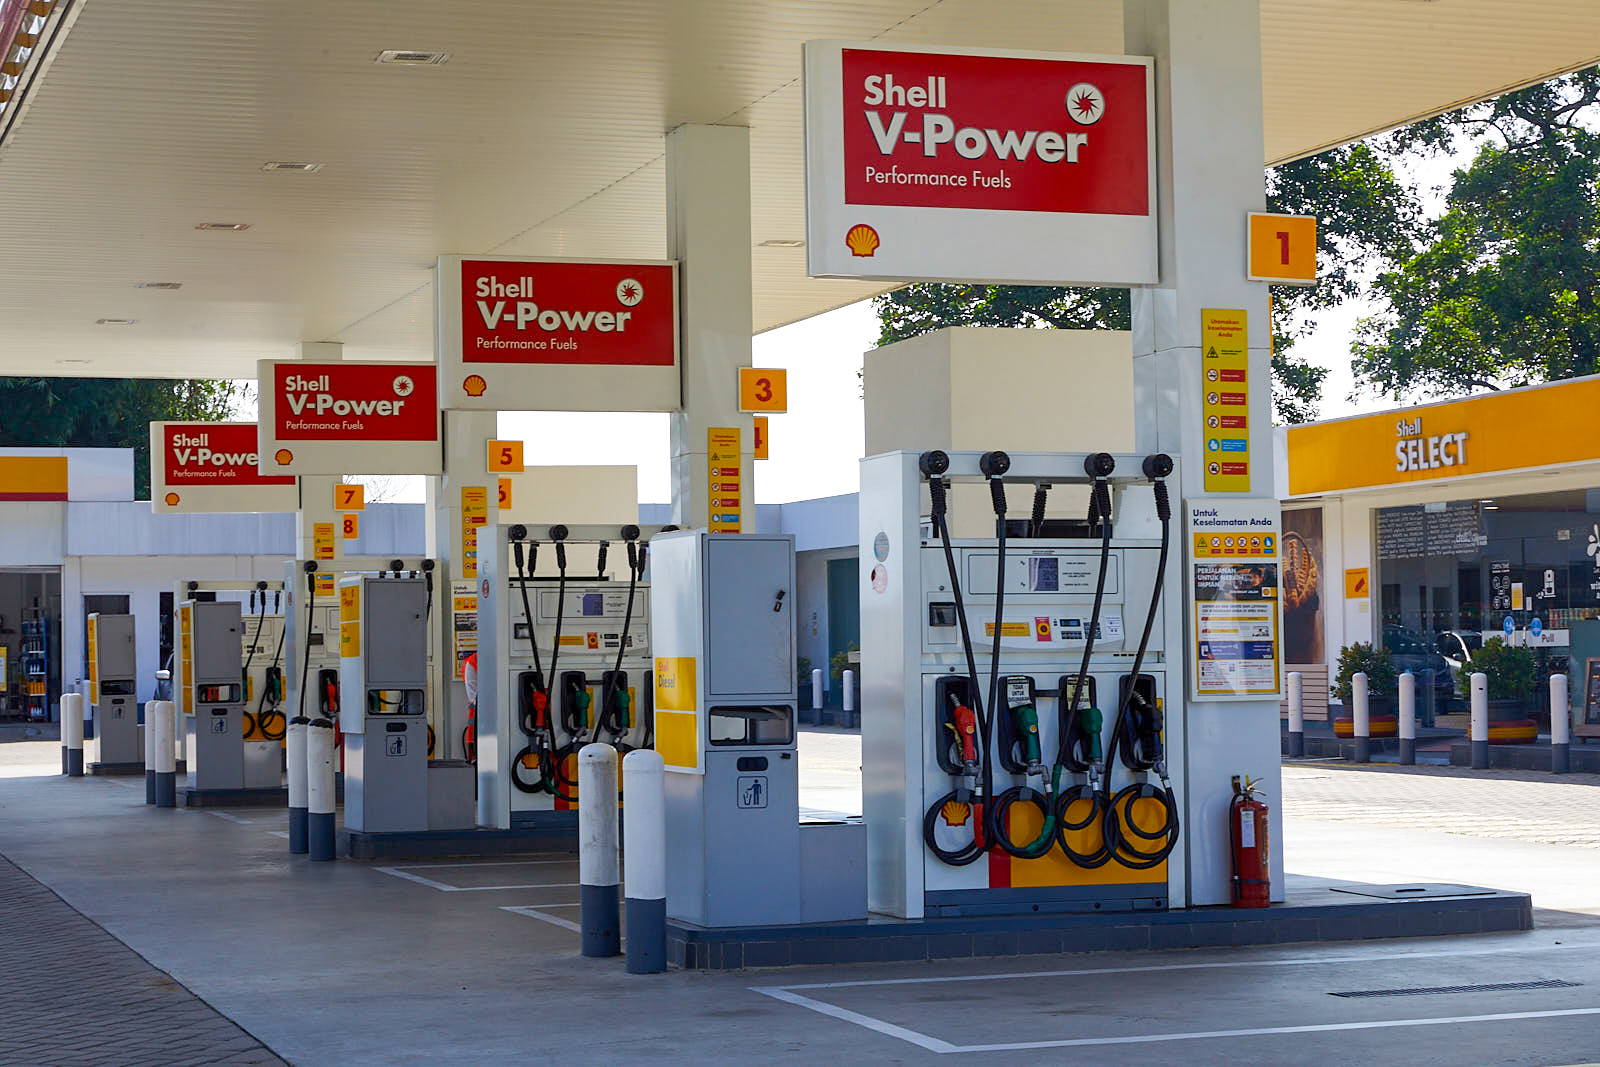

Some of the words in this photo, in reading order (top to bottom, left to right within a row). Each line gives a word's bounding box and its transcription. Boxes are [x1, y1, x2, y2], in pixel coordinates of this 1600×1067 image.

[863, 73, 947, 108] Shell
[864, 110, 1088, 164] V-Power
[865, 165, 968, 187] Performance
[972, 170, 1012, 189] Fuels
[1276, 231, 1289, 265] 1
[476, 276, 534, 298] Shell
[476, 300, 632, 333] V-Power
[476, 336, 547, 350] Performance
[550, 337, 578, 350] Fuels
[285, 375, 329, 392] Shell
[755, 378, 772, 402] 3
[286, 393, 405, 416] V-Power
[286, 419, 340, 430] Performance
[342, 420, 364, 430] Fuels
[1396, 416, 1422, 437] Shell
[173, 433, 208, 447] Shell
[173, 448, 258, 466] V-Powe
[500, 448, 513, 465] 5
[1395, 432, 1470, 472] SELECT
[173, 469, 218, 477] Performance
[344, 490, 355, 504] 7
[1193, 508, 1218, 517] Untuk
[343, 519, 353, 533] 8
[1193, 518, 1248, 526] Keselamatan
[1250, 517, 1272, 526] Anda
[1541, 633, 1555, 643] Pull
